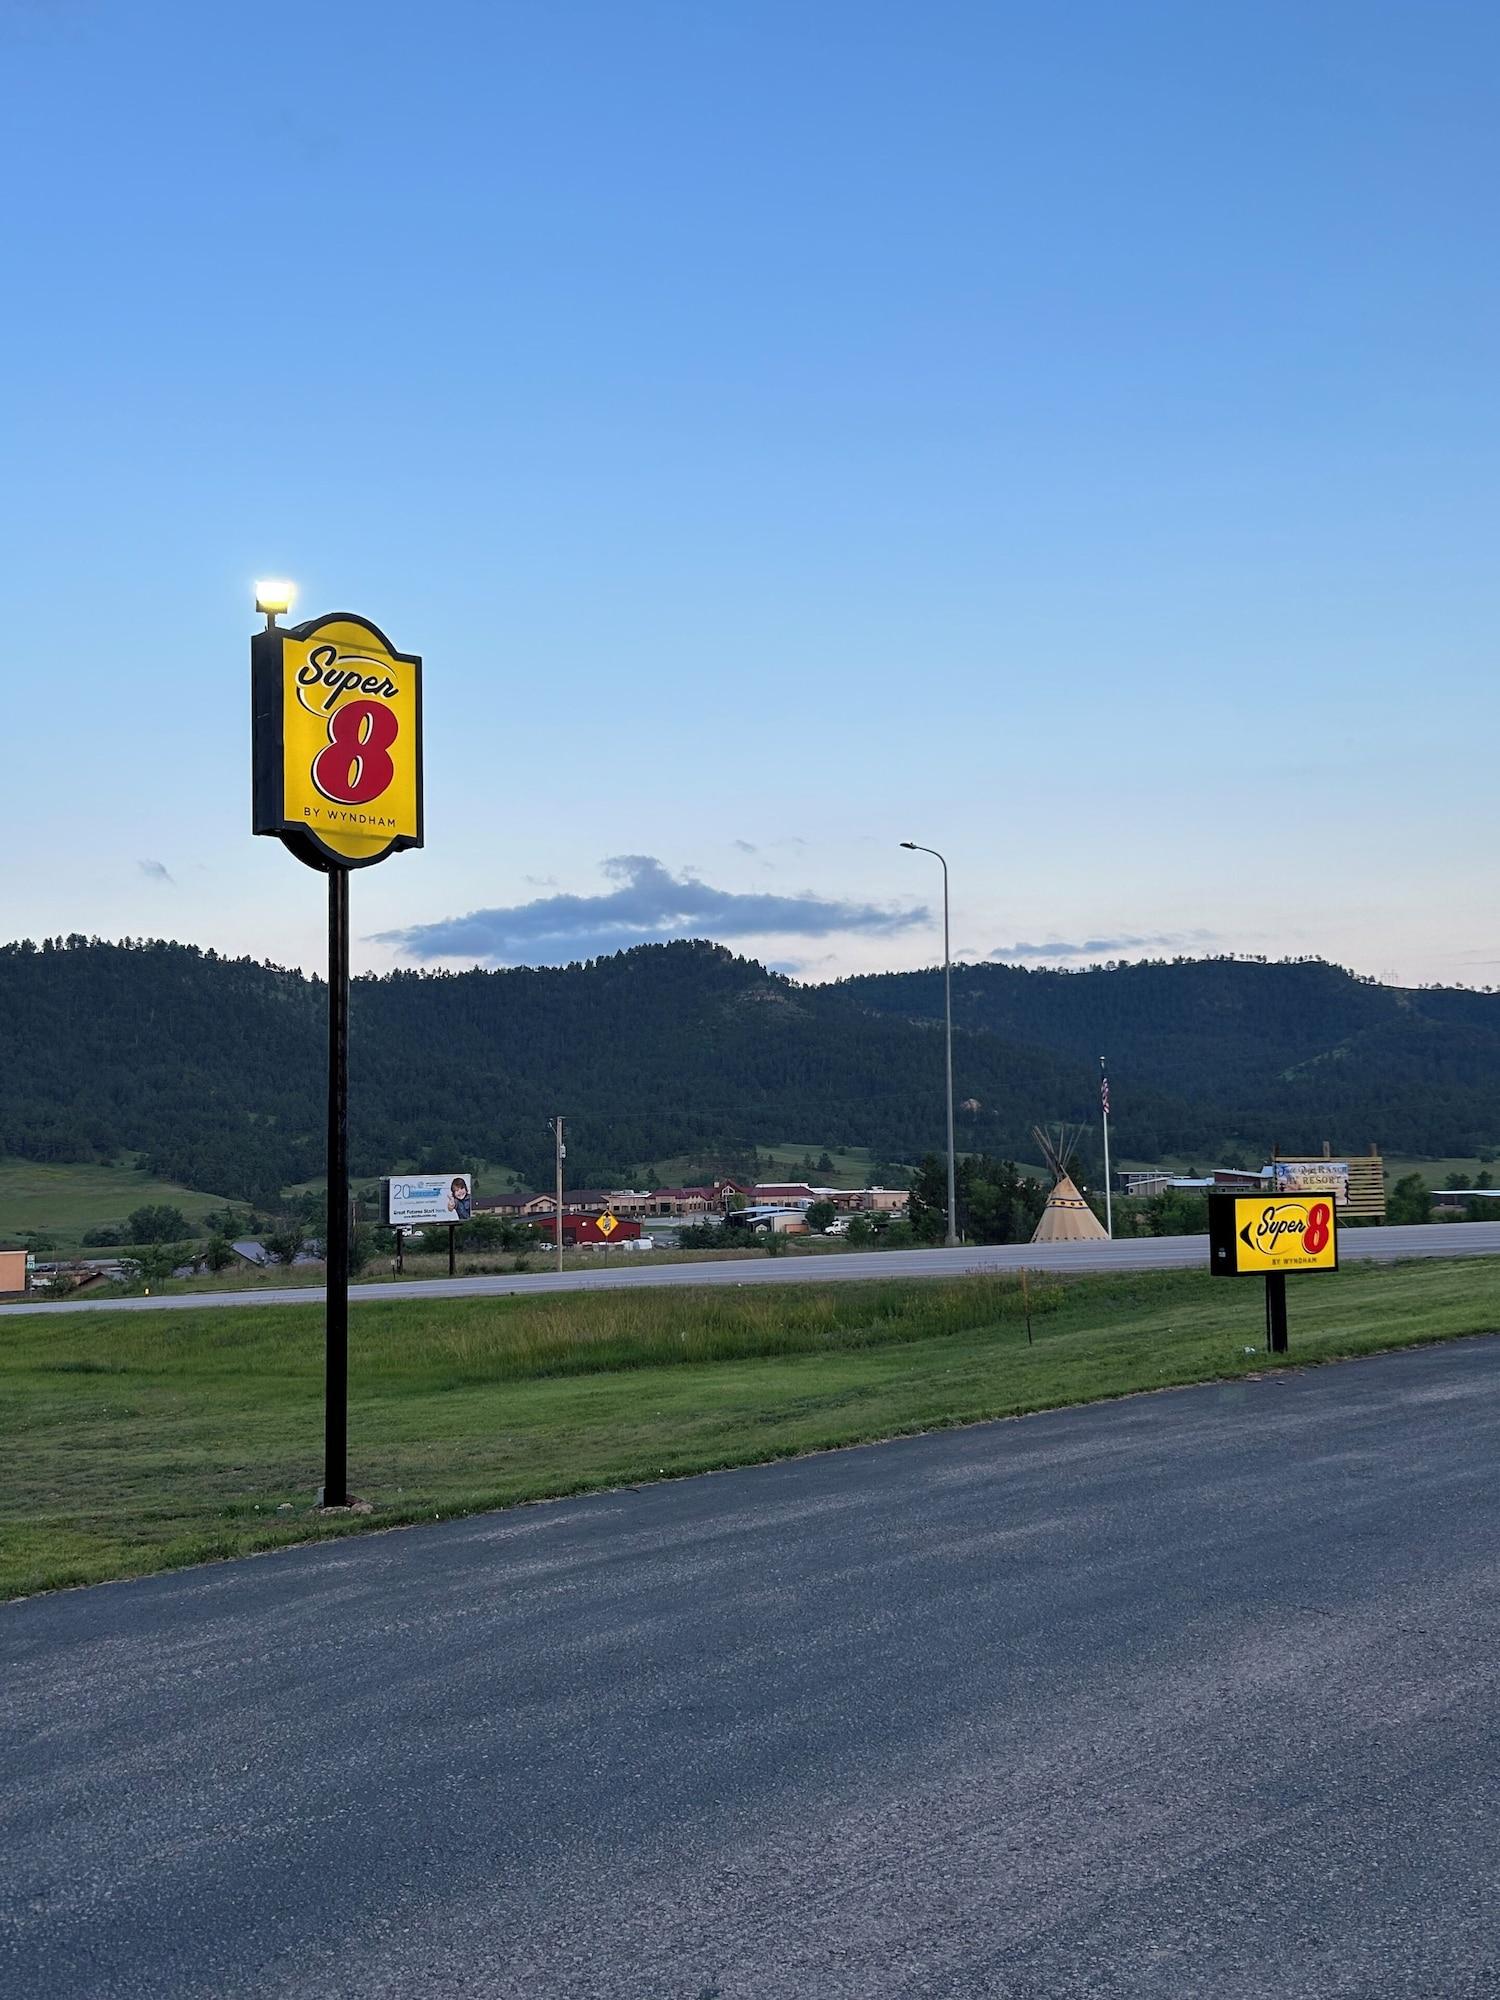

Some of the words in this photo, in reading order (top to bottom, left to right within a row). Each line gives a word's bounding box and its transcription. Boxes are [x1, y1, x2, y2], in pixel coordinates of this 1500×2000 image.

[297, 645, 399, 710] Super
[311, 700, 399, 806] 8
[304, 807, 320, 818] BY
[327, 809, 396, 828] WYNDHAM
[393, 1183, 411, 1199] 20
[1302, 1176, 1341, 1185] RESORT
[1257, 1206, 1307, 1250] Super
[1301, 1203, 1331, 1255] 8
[1283, 1257, 1318, 1265] WYNDHAM
